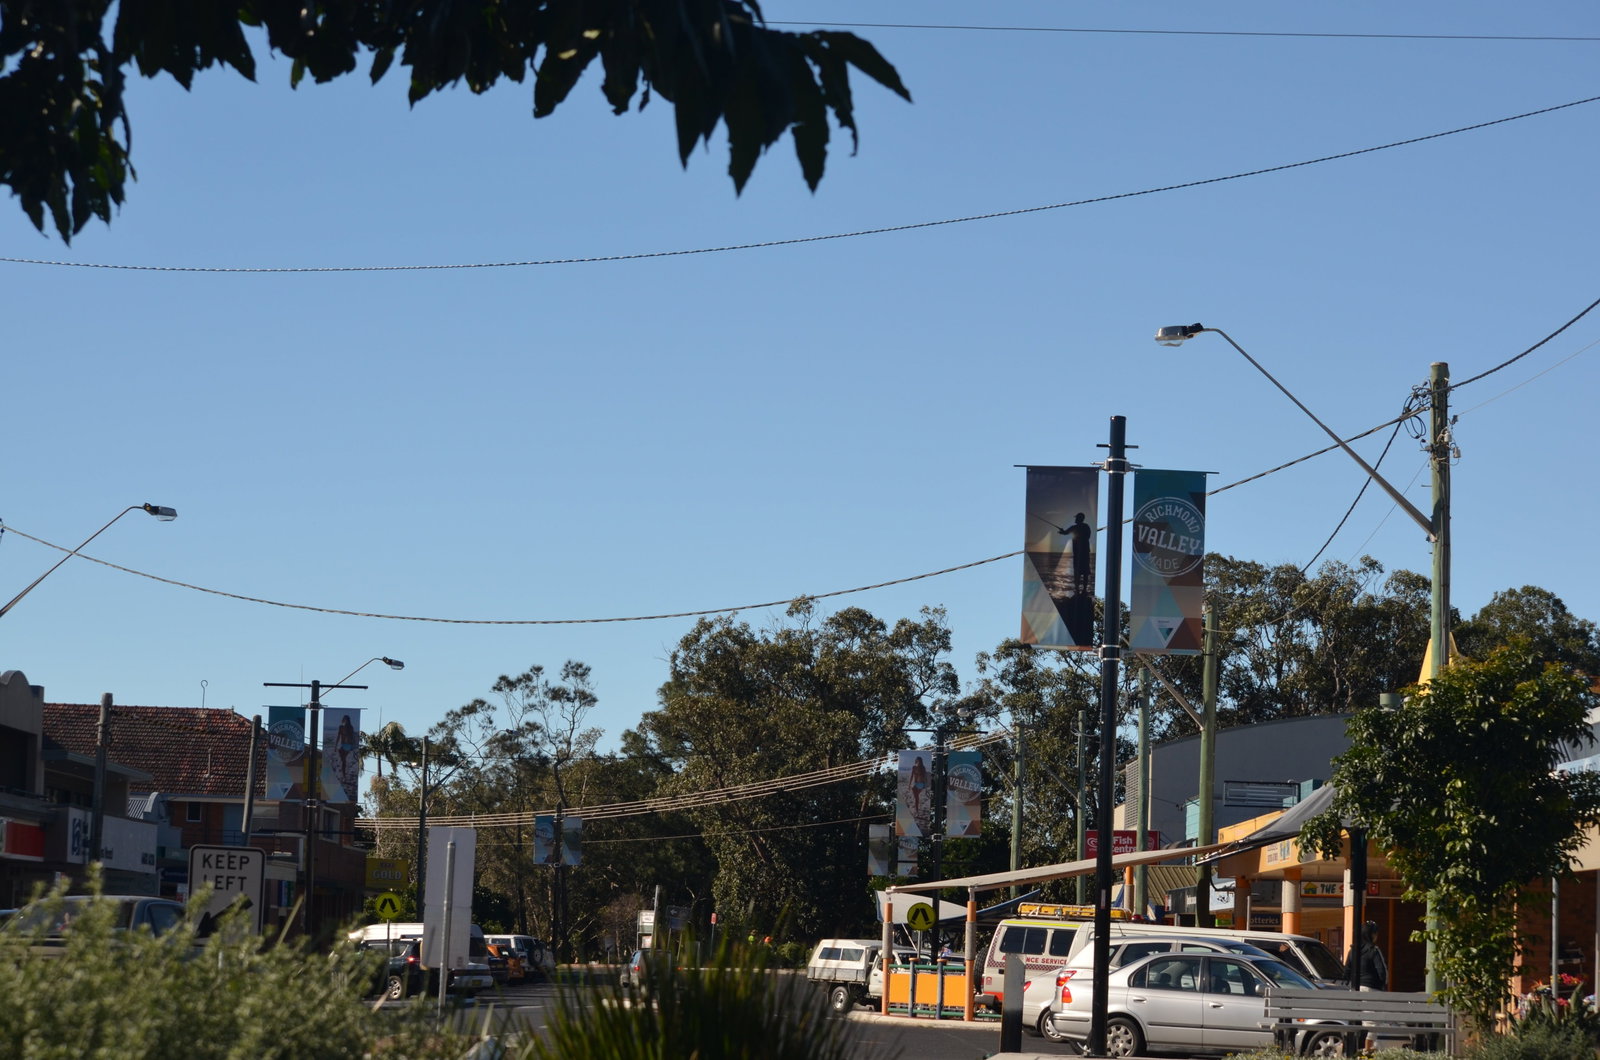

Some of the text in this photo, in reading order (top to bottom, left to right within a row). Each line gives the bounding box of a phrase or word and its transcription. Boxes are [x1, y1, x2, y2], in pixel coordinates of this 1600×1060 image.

[1146, 504, 1201, 533] RICHMOND
[1138, 525, 1201, 555] VALLEY
[1149, 552, 1180, 570] MADE
[269, 734, 303, 751] VALLEY
[949, 776, 981, 791] VALLEY
[1113, 836, 1133, 845] Fish
[202, 853, 250, 870] KEEP
[372, 870, 402, 880] GOLD
[1320, 883, 1337, 894] THE
